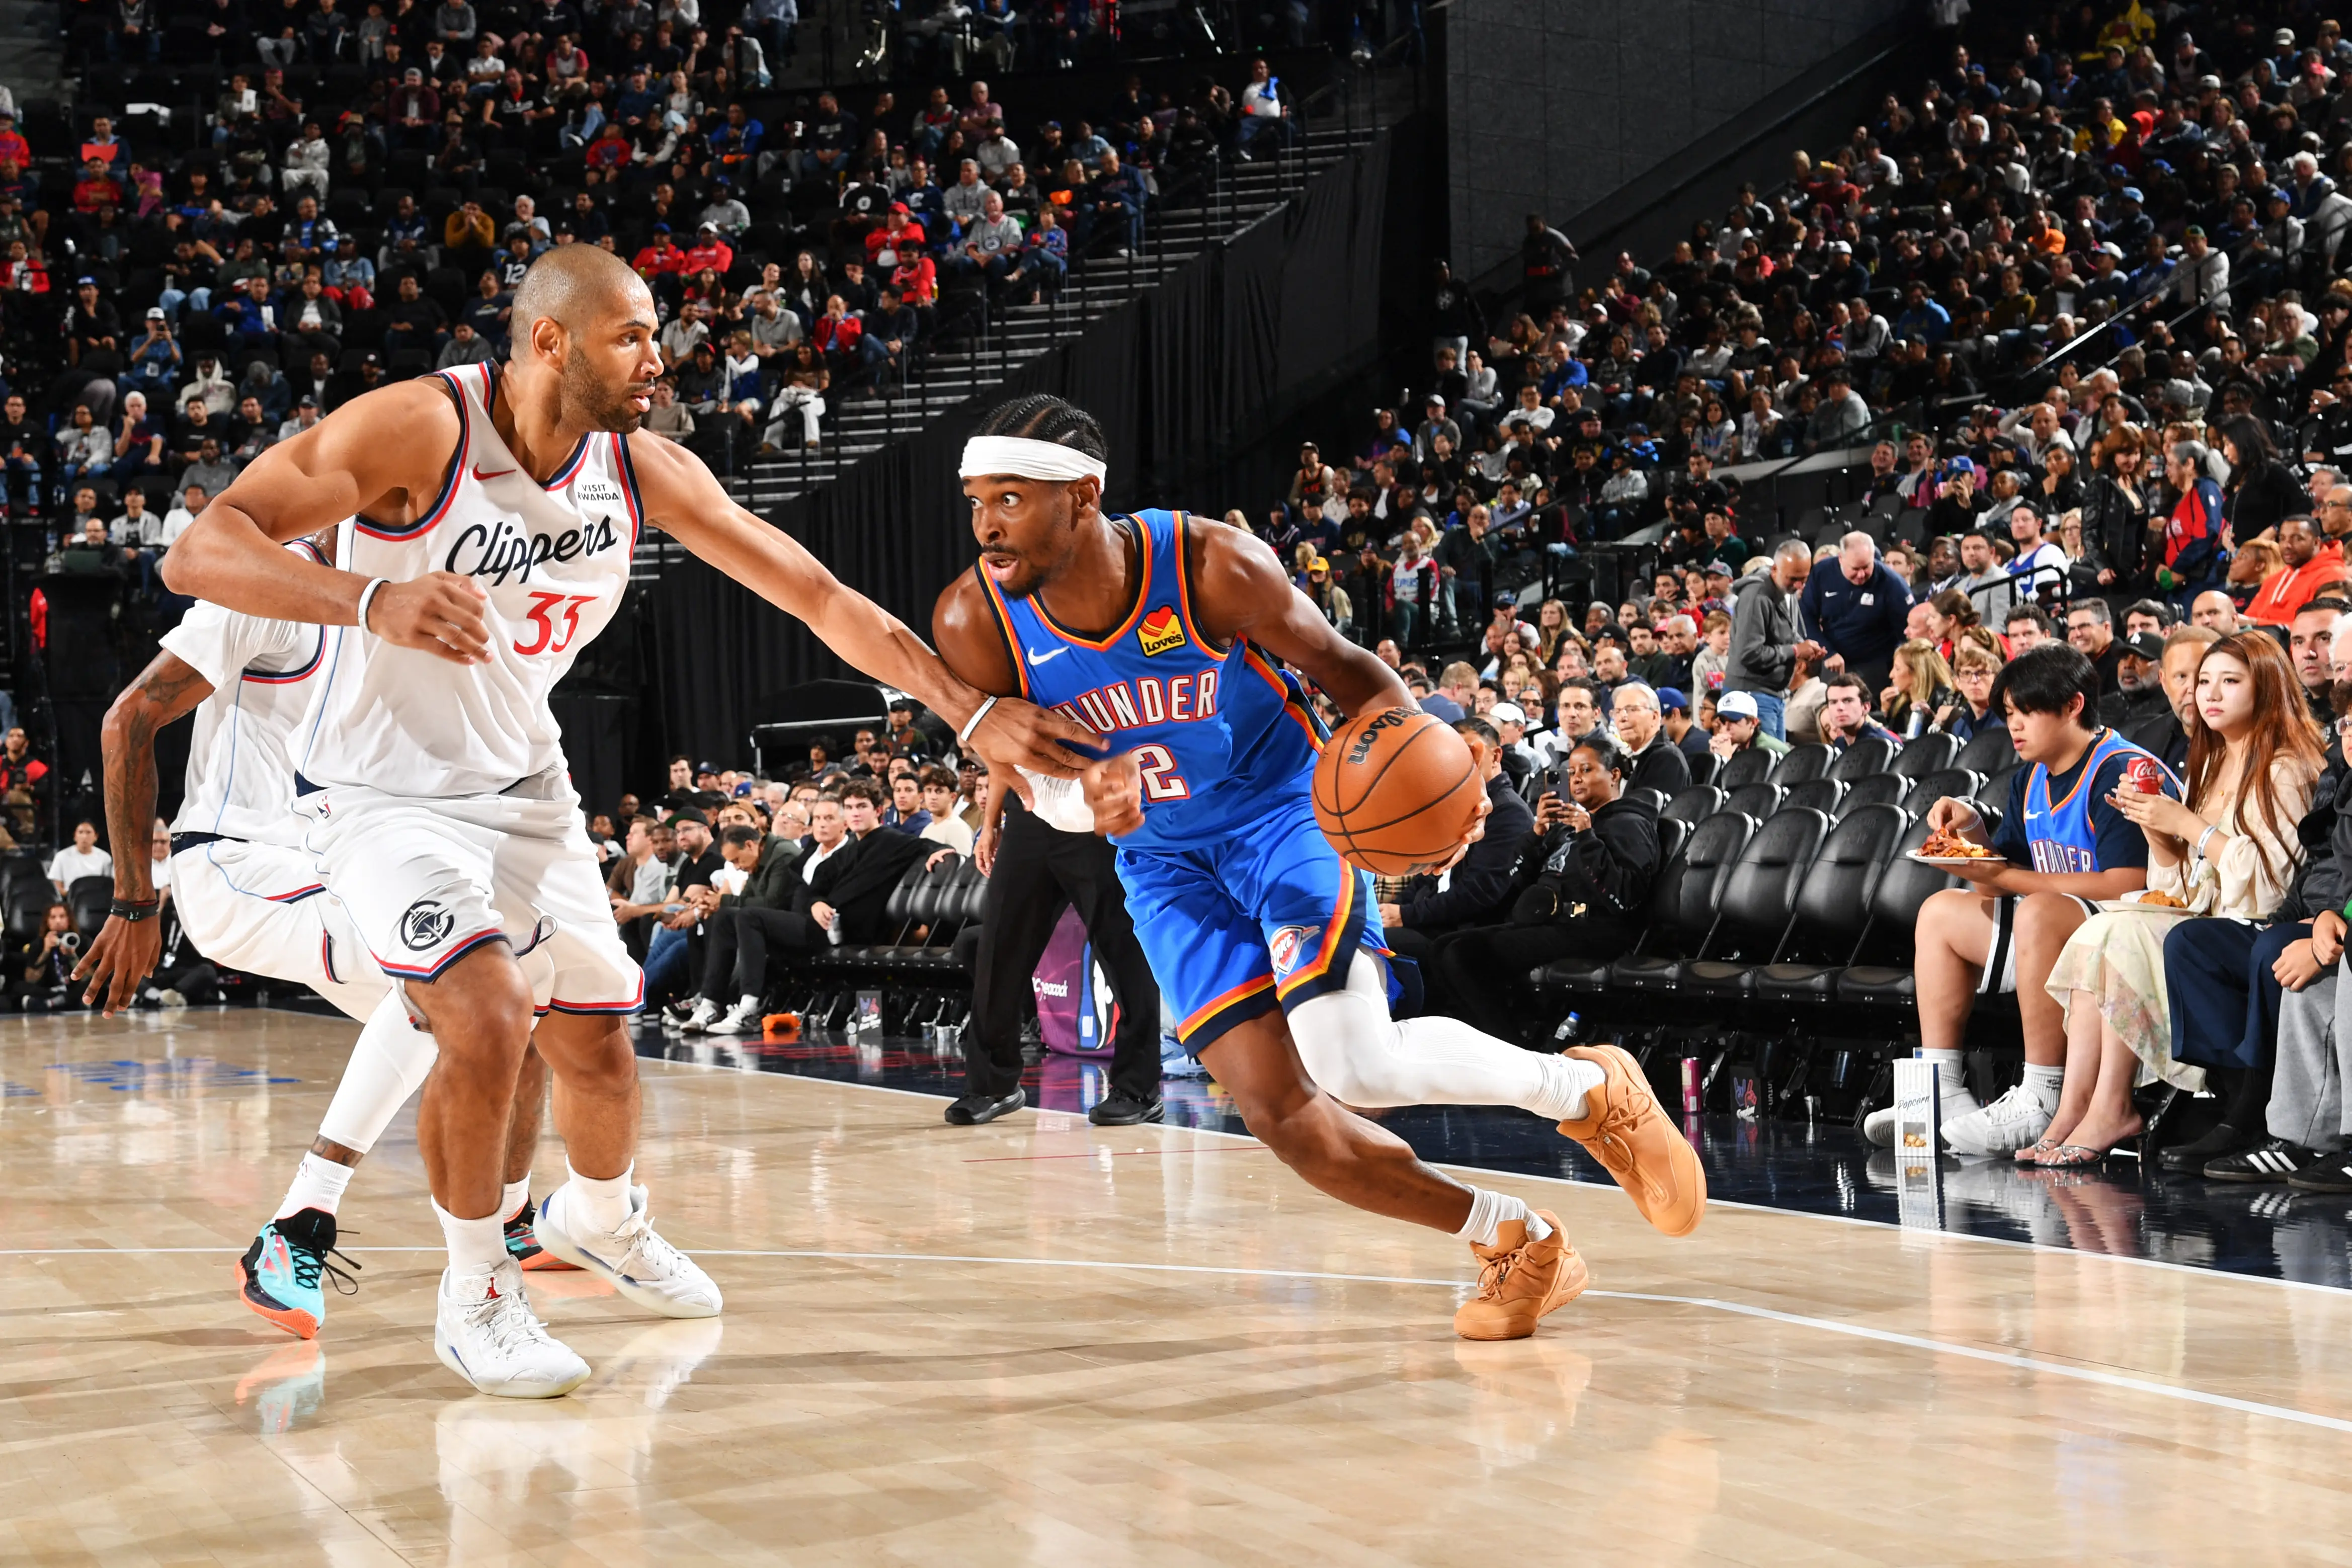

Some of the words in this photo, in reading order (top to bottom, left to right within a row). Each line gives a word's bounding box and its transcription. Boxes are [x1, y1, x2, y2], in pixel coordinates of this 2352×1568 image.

[505, 264, 527, 284] 12
[577, 491, 620, 501] RWANDA
[582, 484, 606, 492] VISIT
[445, 515, 618, 587] Clippers
[513, 591, 599, 655] 33
[1048, 668, 1219, 734] HUNDER
[1128, 742, 1191, 803] 2
[1897, 1095, 1930, 1110] Popcorn
